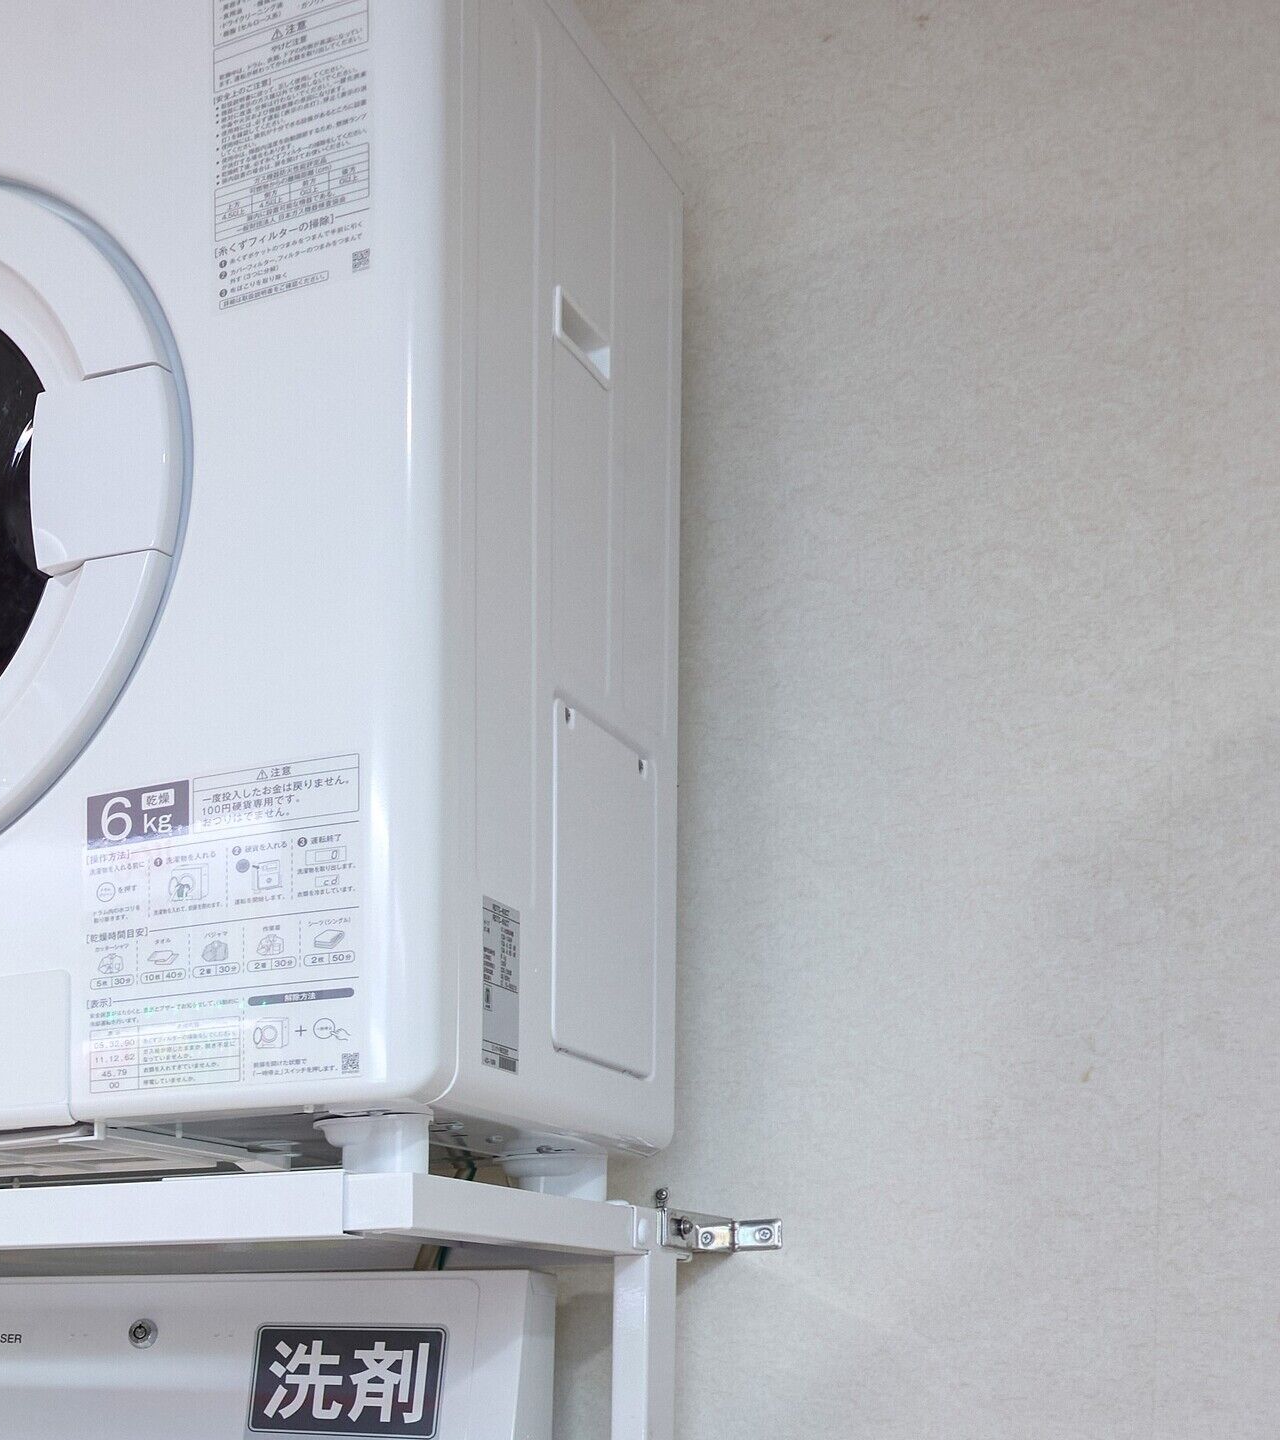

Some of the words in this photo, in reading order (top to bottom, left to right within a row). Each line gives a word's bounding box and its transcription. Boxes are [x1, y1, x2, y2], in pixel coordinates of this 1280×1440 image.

[271, 766, 292, 778] 注意
[146, 791, 170, 806] 乾燥
[202, 774, 350, 804] 一度投入したお金は戻りません。
[202, 792, 300, 815] 100円硬貨専用です。
[262, 1339, 430, 1424] 洗剤
